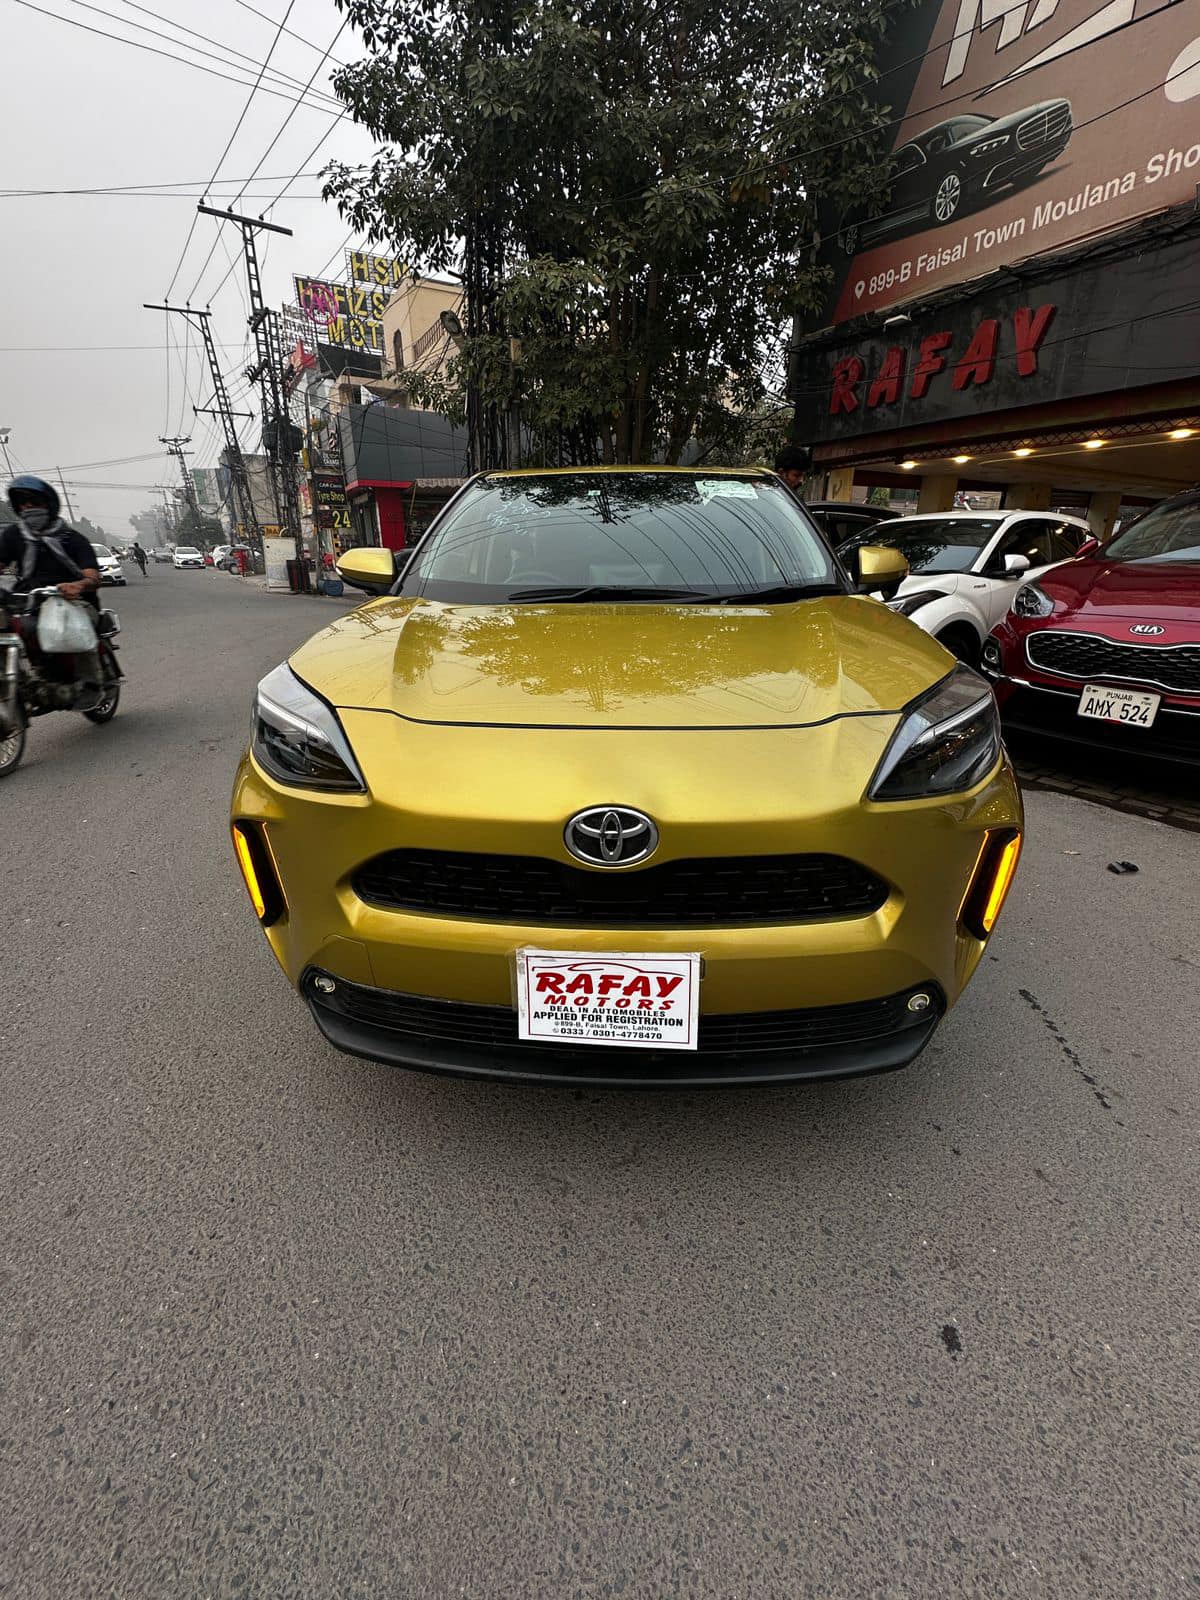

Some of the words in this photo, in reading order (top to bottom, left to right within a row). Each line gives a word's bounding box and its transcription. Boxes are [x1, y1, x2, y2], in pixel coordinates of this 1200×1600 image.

[869, 261, 911, 296] 899-B
[916, 240, 968, 277] Faisal
[974, 217, 1027, 254] Town
[1032, 171, 1136, 230] Moulana
[829, 303, 1056, 415] RAFAY
[332, 510, 352, 528] 24
[1134, 624, 1158, 634] KIA
[1106, 691, 1133, 702] PUNJAB
[1084, 698, 1115, 718] AMX
[1120, 703, 1150, 724] 524
[535, 972, 684, 998] RAFAY
[544, 995, 675, 1011] MOTORS
[533, 1011, 577, 1021] APPLIED
[581, 1012, 603, 1023] FOR
[606, 1014, 683, 1027] REGISTRATION
[550, 1005, 575, 1013] DEAL
[592, 1007, 666, 1018] AUTOMOBILES
[560, 1027, 584, 1036] 0333
[592, 1029, 662, 1040] 0301-4778470
[585, 1021, 607, 1030] Faisal
